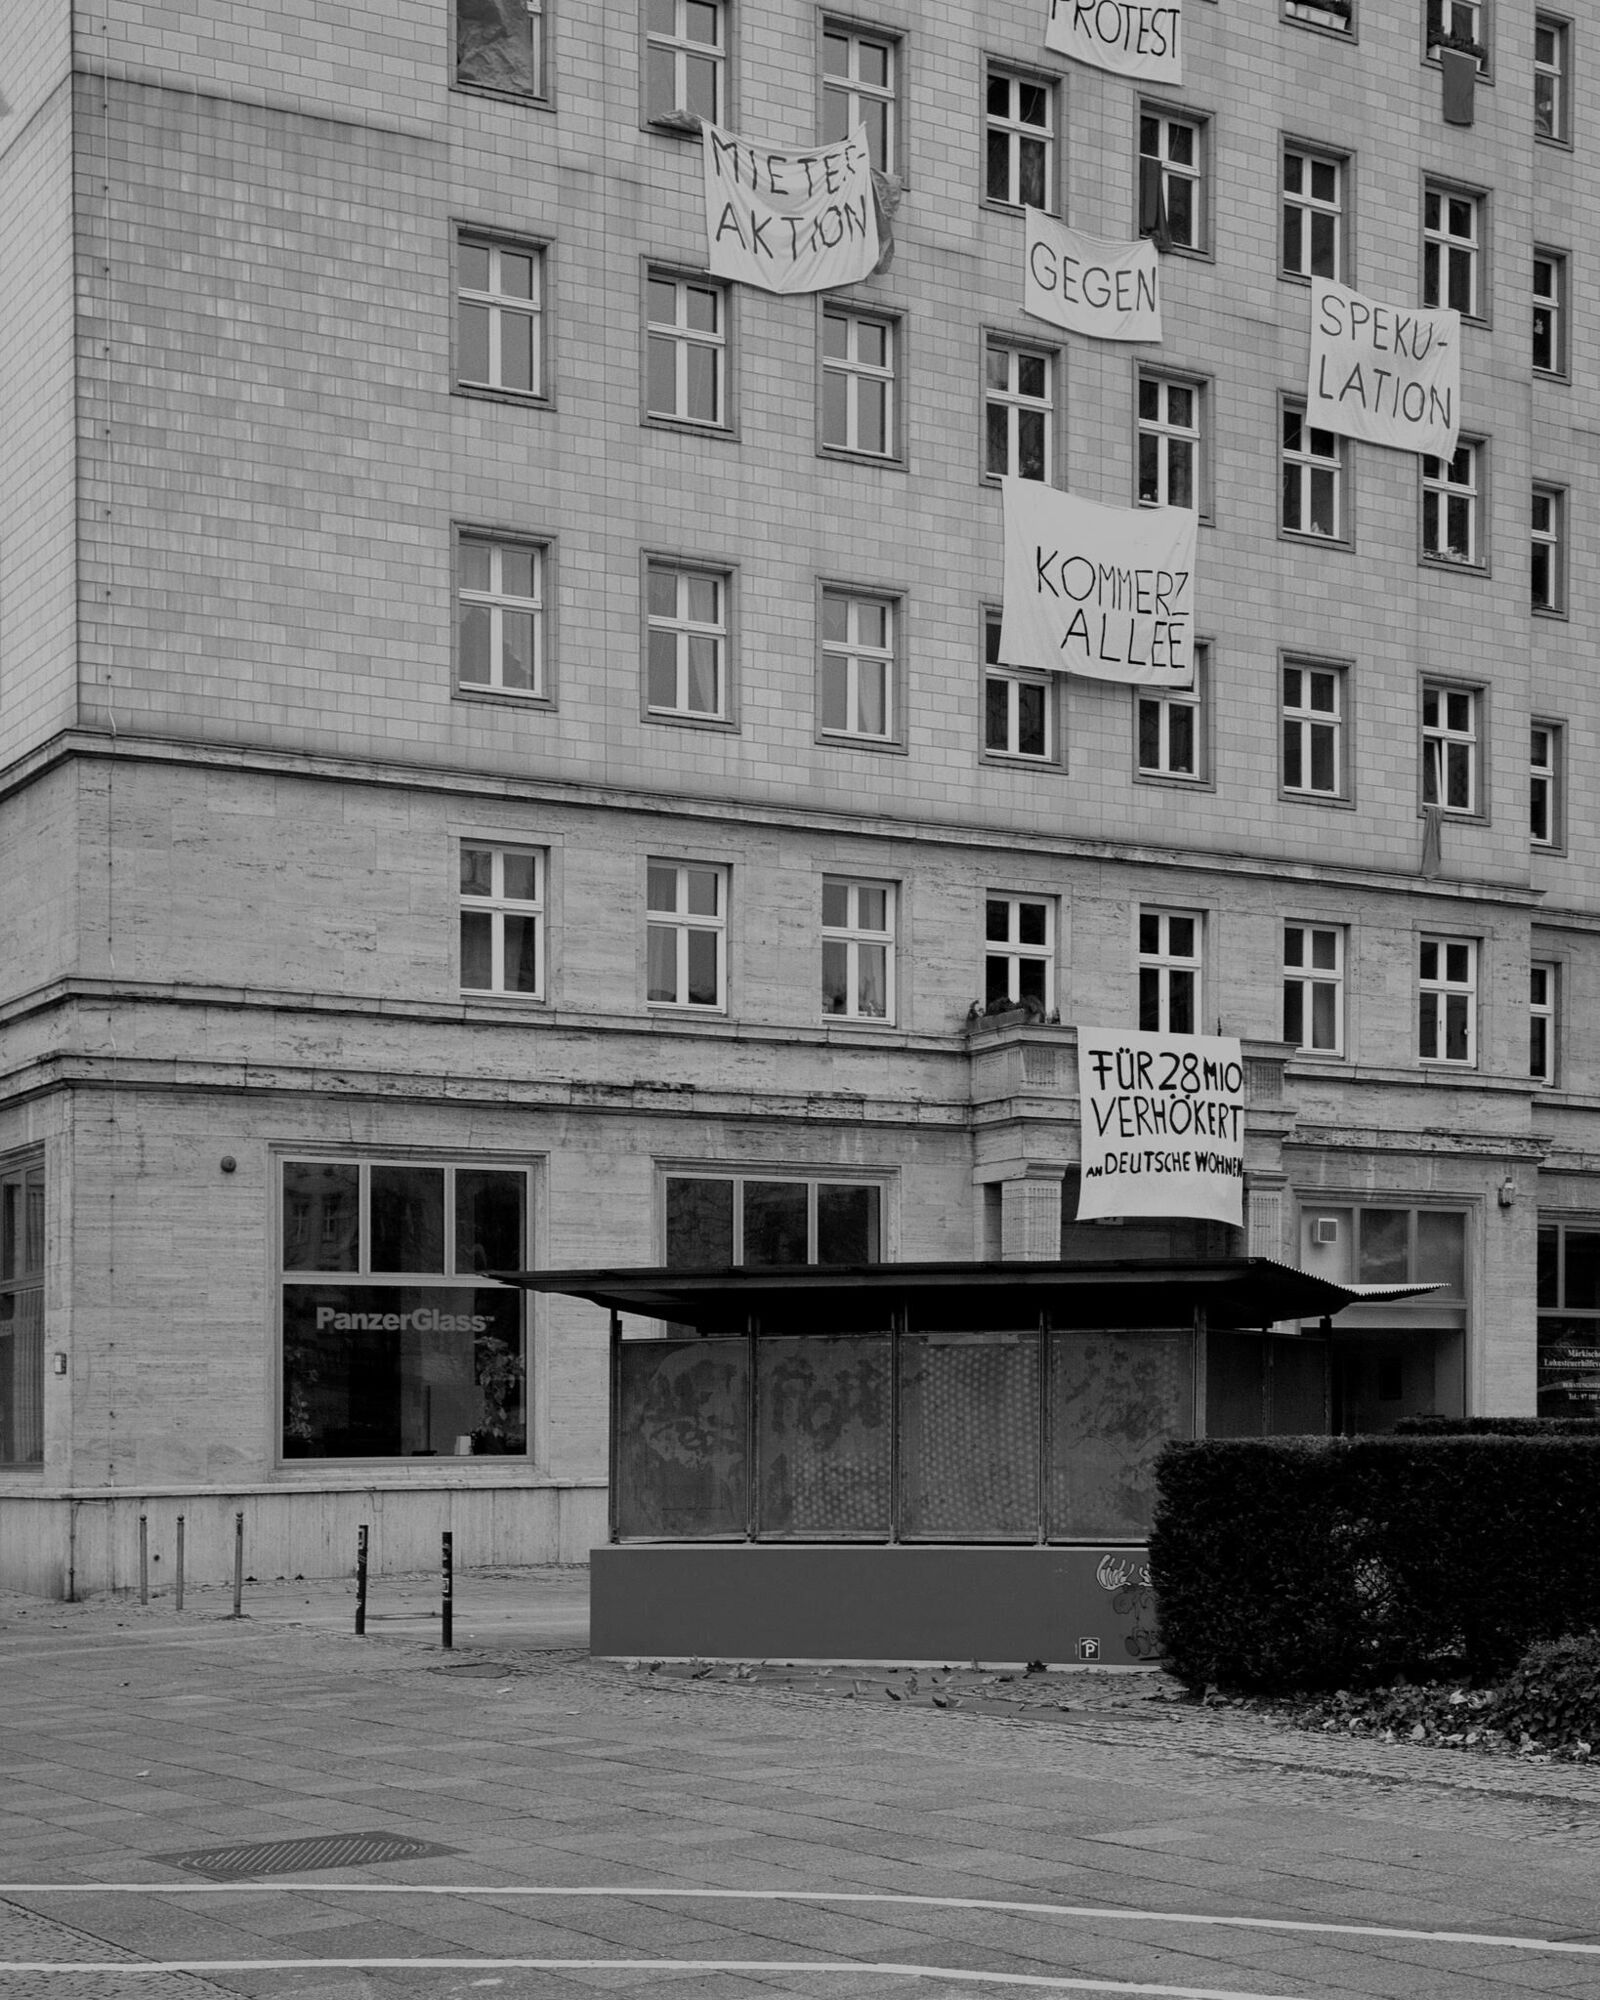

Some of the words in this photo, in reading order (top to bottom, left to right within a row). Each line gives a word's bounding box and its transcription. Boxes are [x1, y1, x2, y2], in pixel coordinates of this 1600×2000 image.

[715, 194, 867, 261] AKTION
[1030, 241, 1156, 312] GEGEN
[1320, 294, 1448, 360] SPEKU-
[1319, 354, 1451, 429] LATION
[1037, 546, 1189, 616] KOMMERZ
[1060, 608, 1186, 668] ALLEE
[1088, 1047, 1153, 1090] FÜR
[1159, 1052, 1200, 1093] 28
[1203, 1056, 1242, 1093] MIO
[1091, 1093, 1243, 1142] VERHÖKERT
[1086, 1166, 1102, 1177] AN
[1105, 1151, 1191, 1174] DEUTSCHE
[1195, 1151, 1243, 1178] WOHNEN
[1086, 1644, 1096, 1657] P
